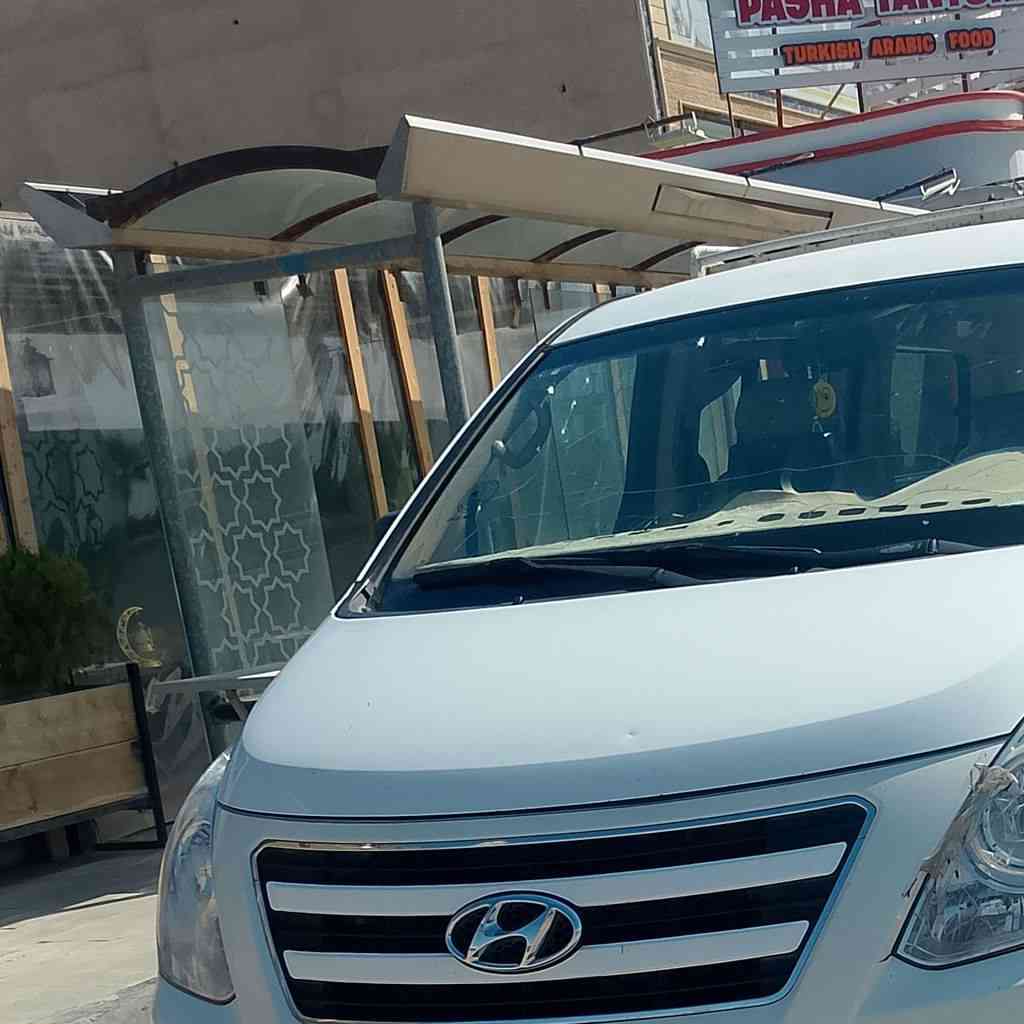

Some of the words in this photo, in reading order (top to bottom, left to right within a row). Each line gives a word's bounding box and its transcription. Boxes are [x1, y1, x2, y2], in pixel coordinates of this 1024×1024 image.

[741, 0, 863, 23] PASHA
[783, 40, 861, 66] TURKISH
[871, 35, 935, 58] ARABIC
[948, 28, 995, 50] FOOD
